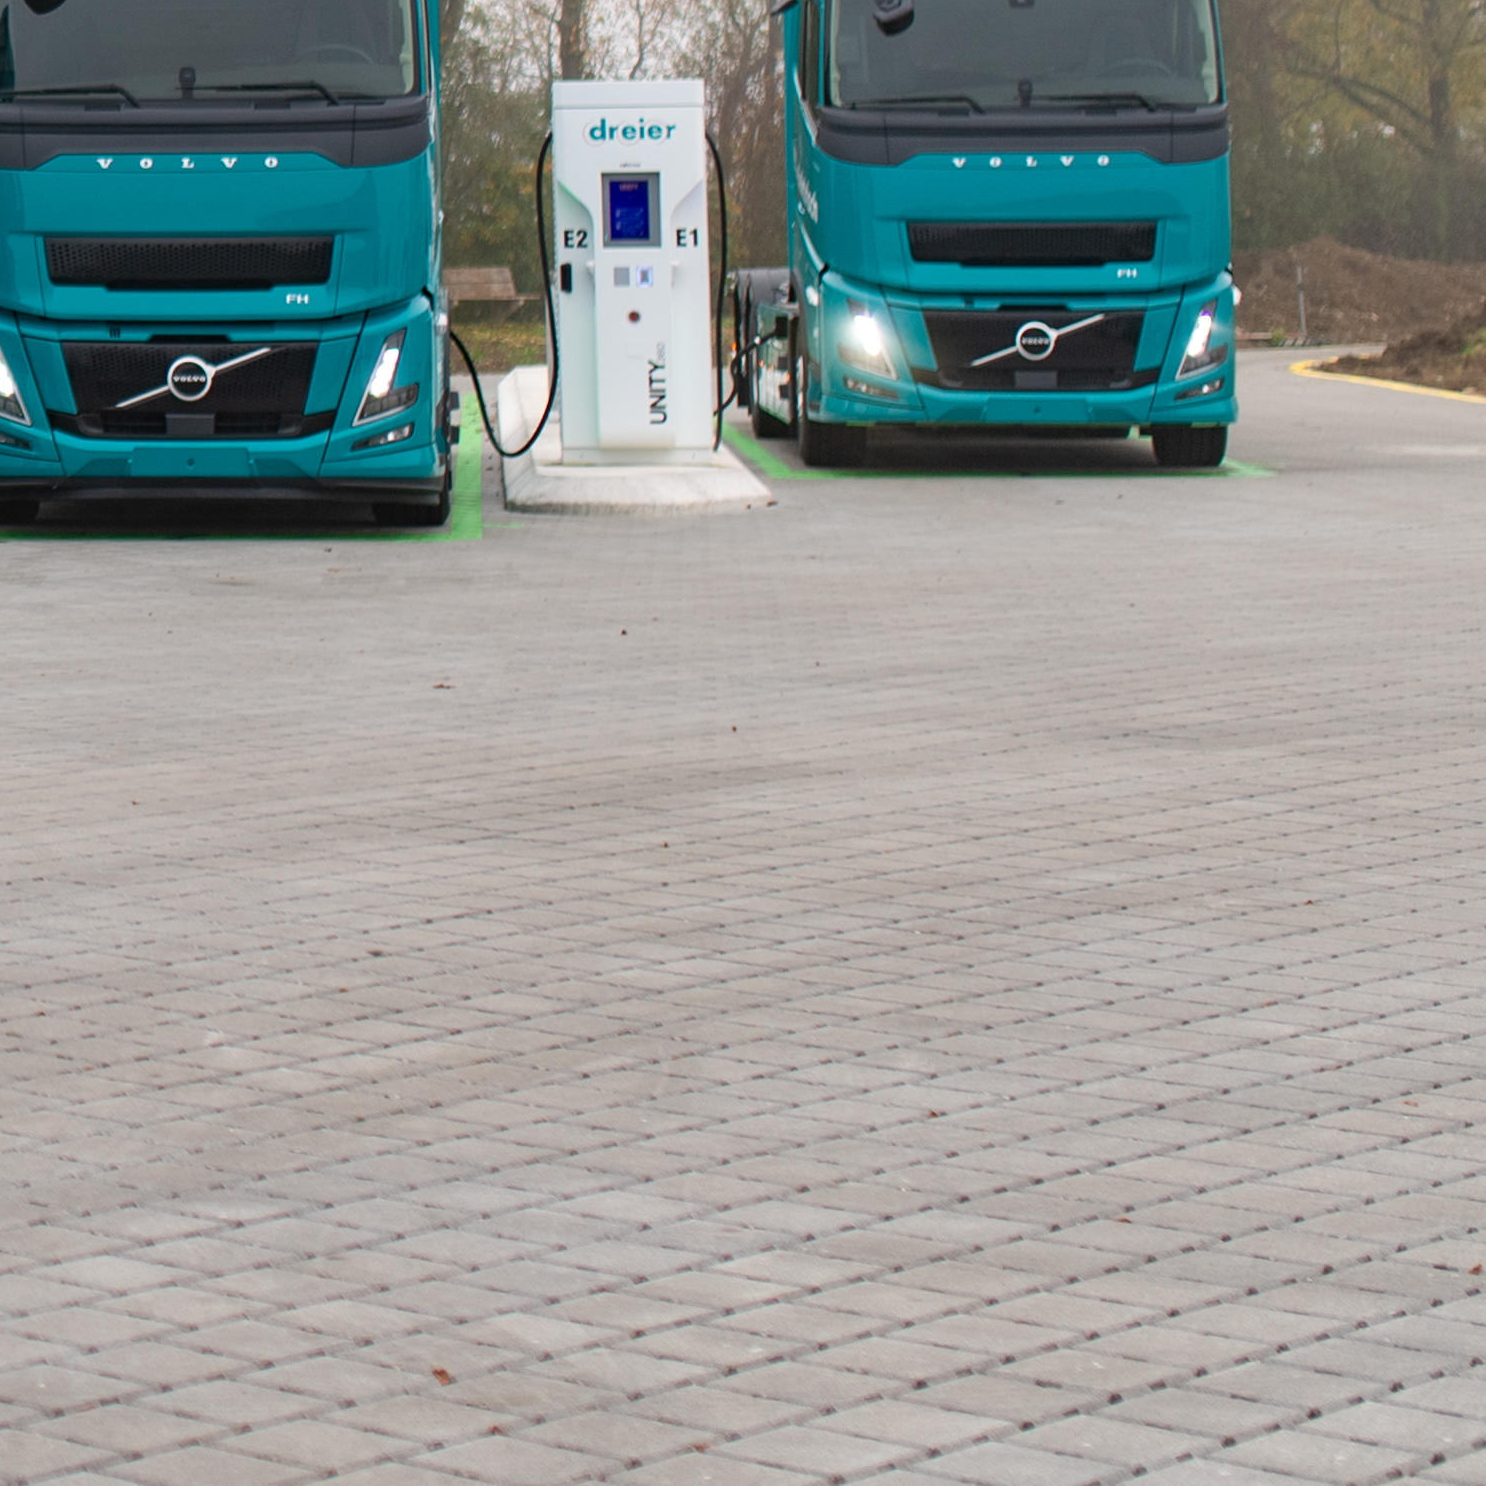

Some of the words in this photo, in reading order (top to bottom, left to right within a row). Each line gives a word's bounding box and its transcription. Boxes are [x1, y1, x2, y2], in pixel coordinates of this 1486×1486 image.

[589, 117, 677, 141] dreier
[96, 155, 279, 170] VOLVO
[952, 154, 1111, 169] VOLVO
[563, 229, 589, 249] E2
[675, 228, 699, 247] E1
[285, 293, 310, 305] FH
[172, 374, 207, 383] VOLVO
[647, 358, 668, 425] UNITY
